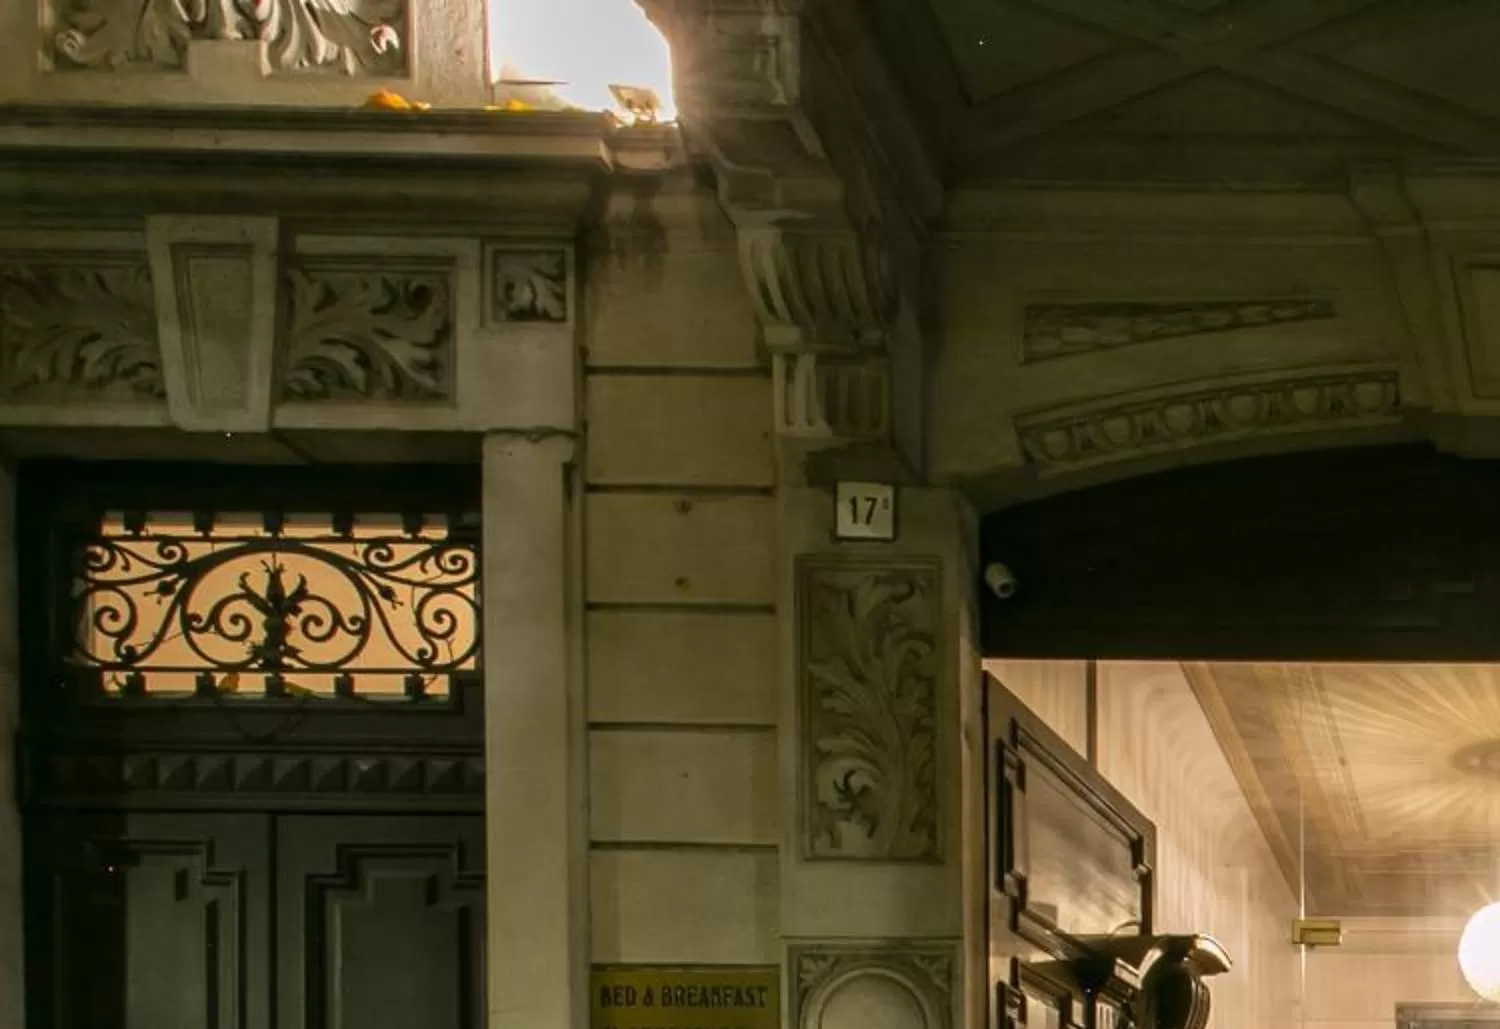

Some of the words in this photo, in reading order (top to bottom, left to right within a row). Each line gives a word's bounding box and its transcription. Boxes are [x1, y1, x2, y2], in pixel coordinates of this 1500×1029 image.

[849, 495, 878, 525] 17
[601, 984, 637, 1008] BED
[661, 985, 768, 1008] BREAKFAST
